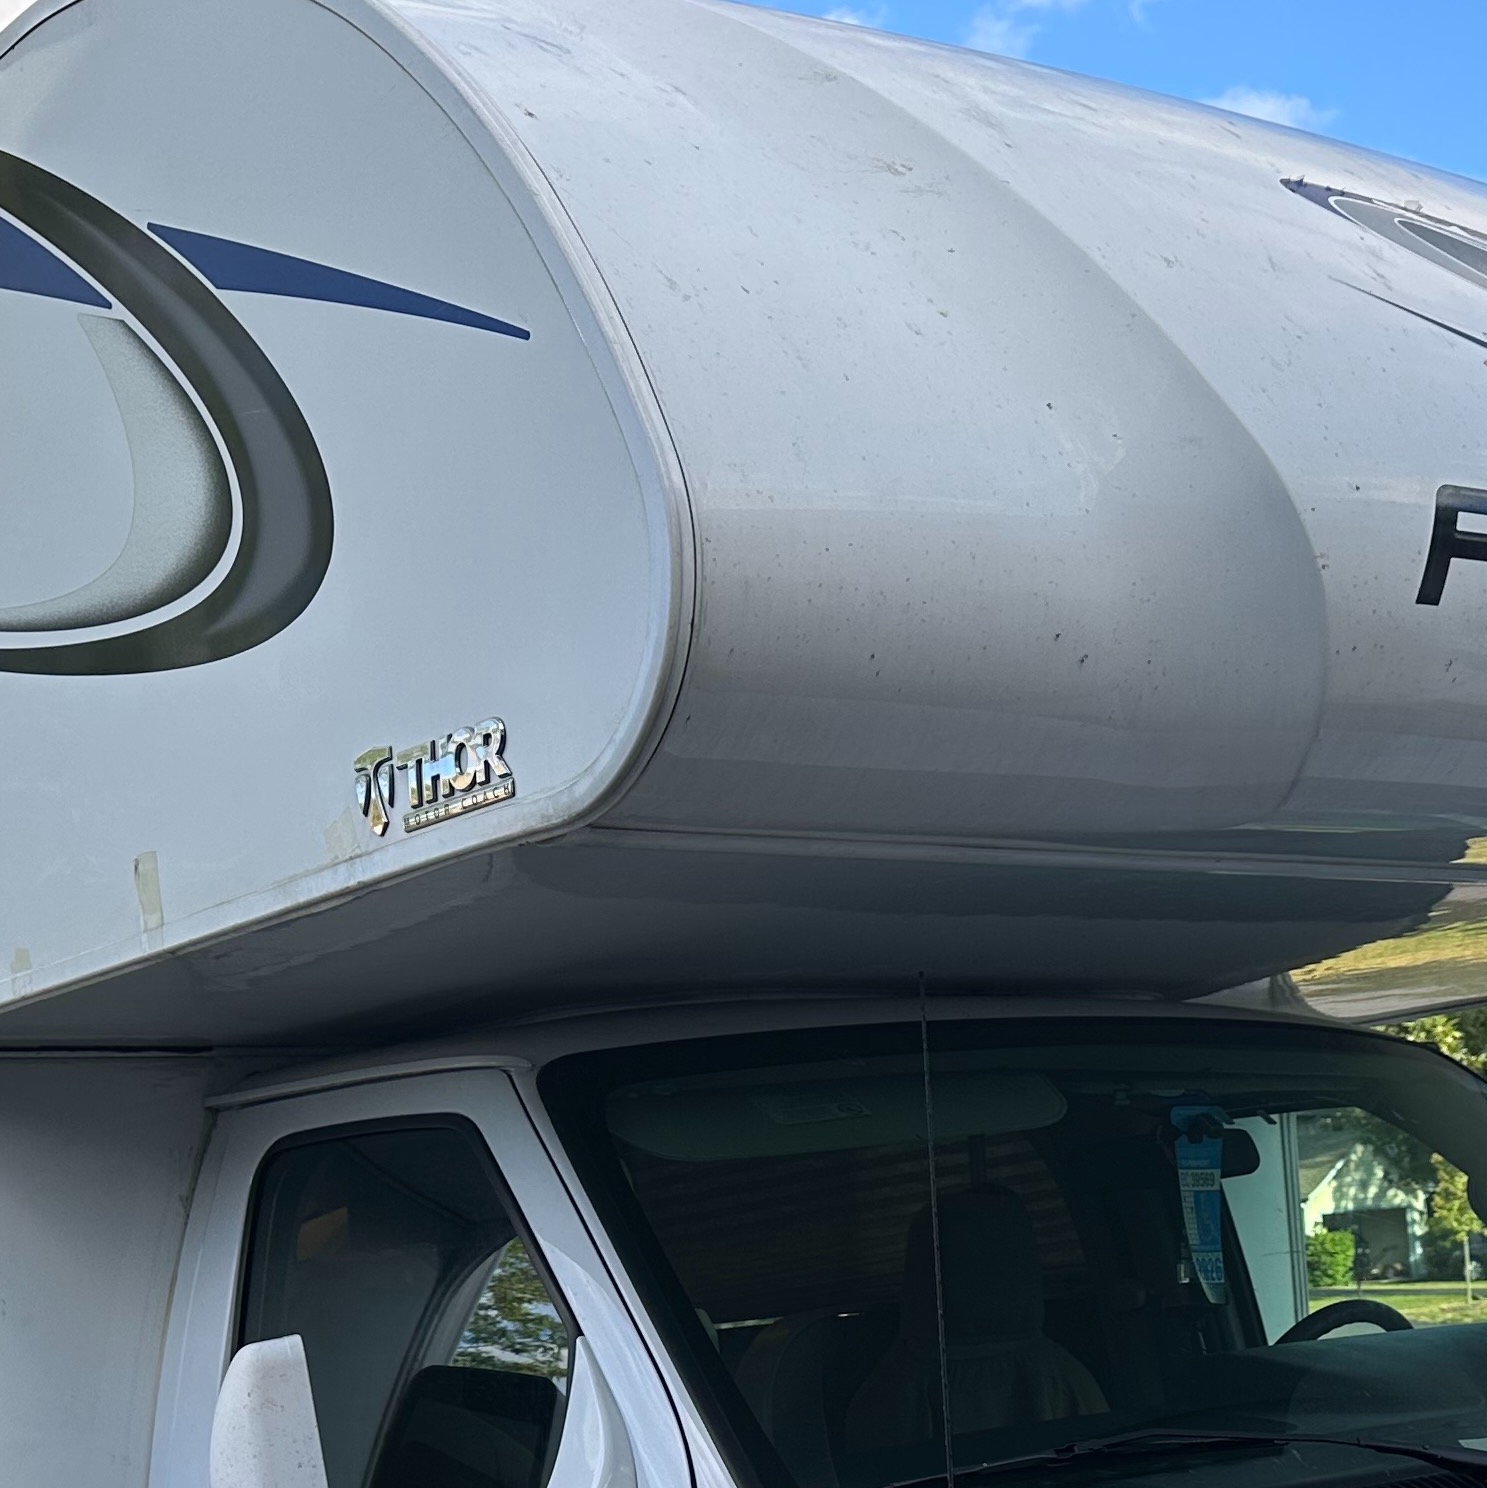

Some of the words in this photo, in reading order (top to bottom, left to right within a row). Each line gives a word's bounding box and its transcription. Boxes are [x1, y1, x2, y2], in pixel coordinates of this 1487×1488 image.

[396, 716, 513, 810] THOR
[403, 803, 451, 829] MOTOR
[462, 782, 513, 810] COACH
